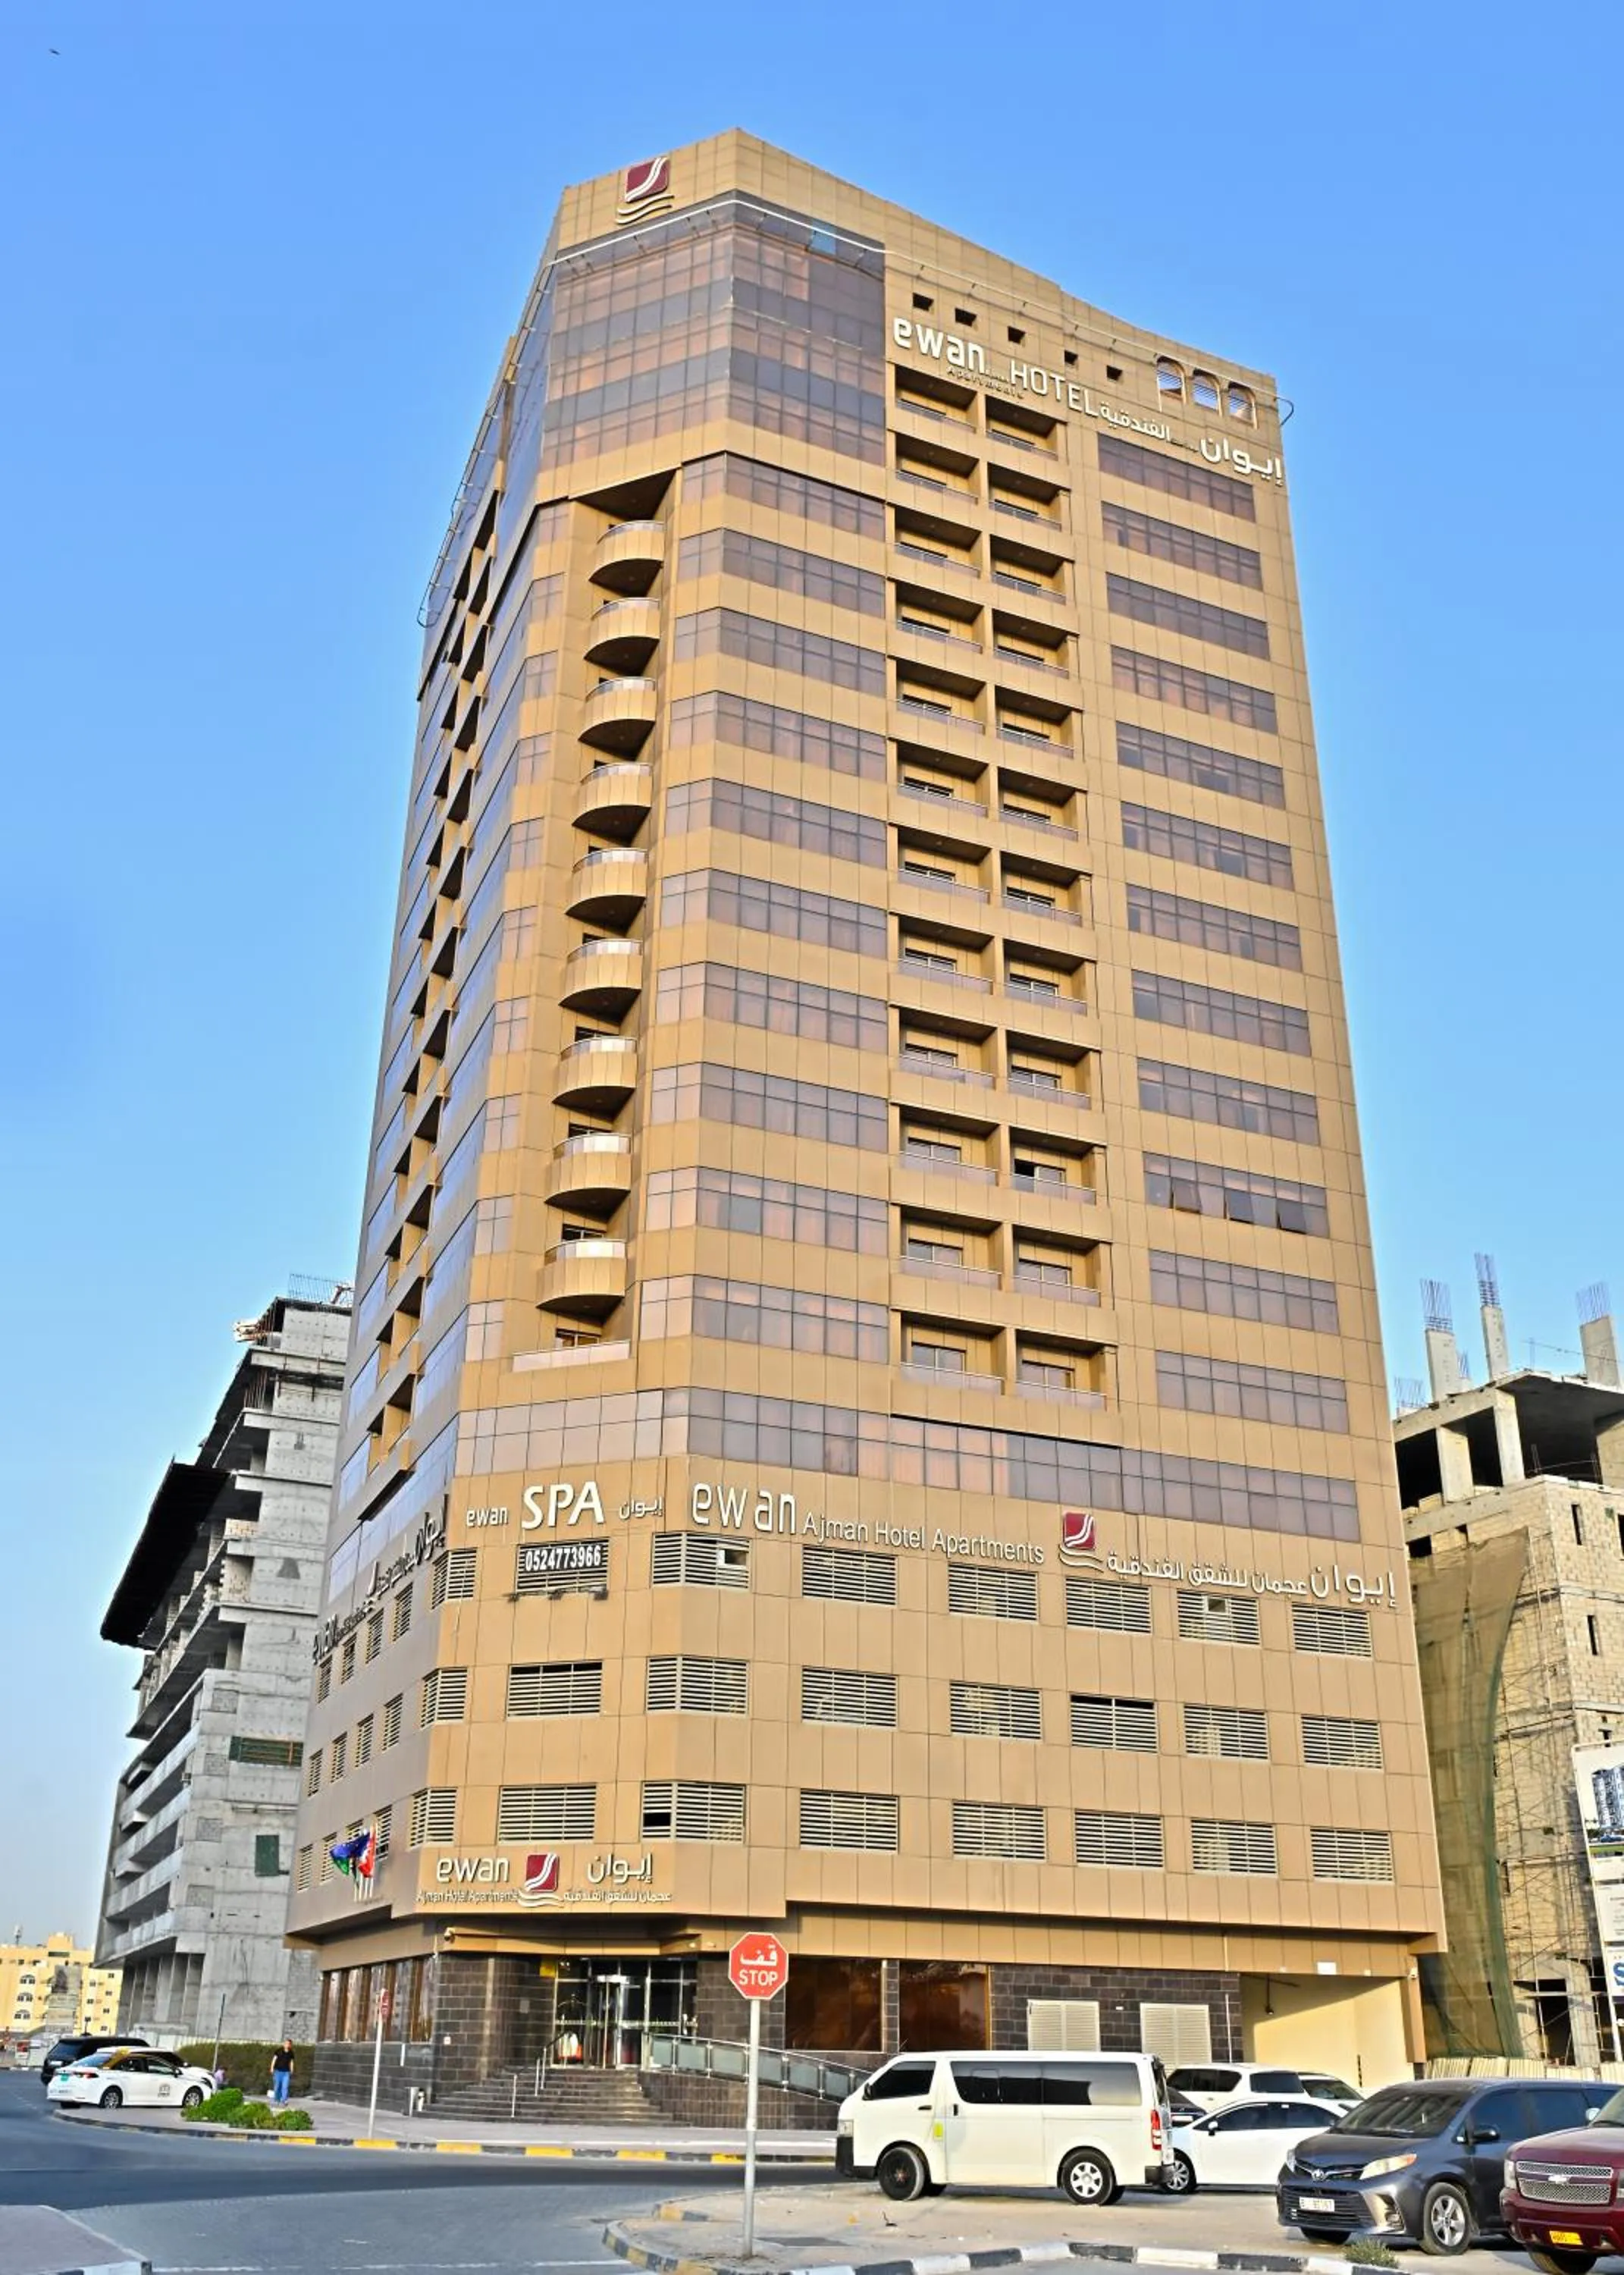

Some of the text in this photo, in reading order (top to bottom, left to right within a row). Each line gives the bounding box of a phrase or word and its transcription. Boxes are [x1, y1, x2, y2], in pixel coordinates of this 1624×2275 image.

[893, 317, 1099, 418] ewan HOTEL
[1100, 400, 1283, 487] إيوان الفندقية
[466, 1480, 604, 1530] ewan SPA
[619, 1496, 664, 1519] إيوان
[692, 1482, 1044, 1564] ewan Ajman Hotel Apartments
[525, 1544, 602, 1572] 0524773966
[1107, 1551, 1398, 1608] إيوان عجمان للشقق الفندقية
[437, 1857, 509, 1883] ewan
[587, 1852, 653, 1884] إيوان
[739, 1944, 777, 1966] قف
[739, 1969, 779, 1986] STOP
